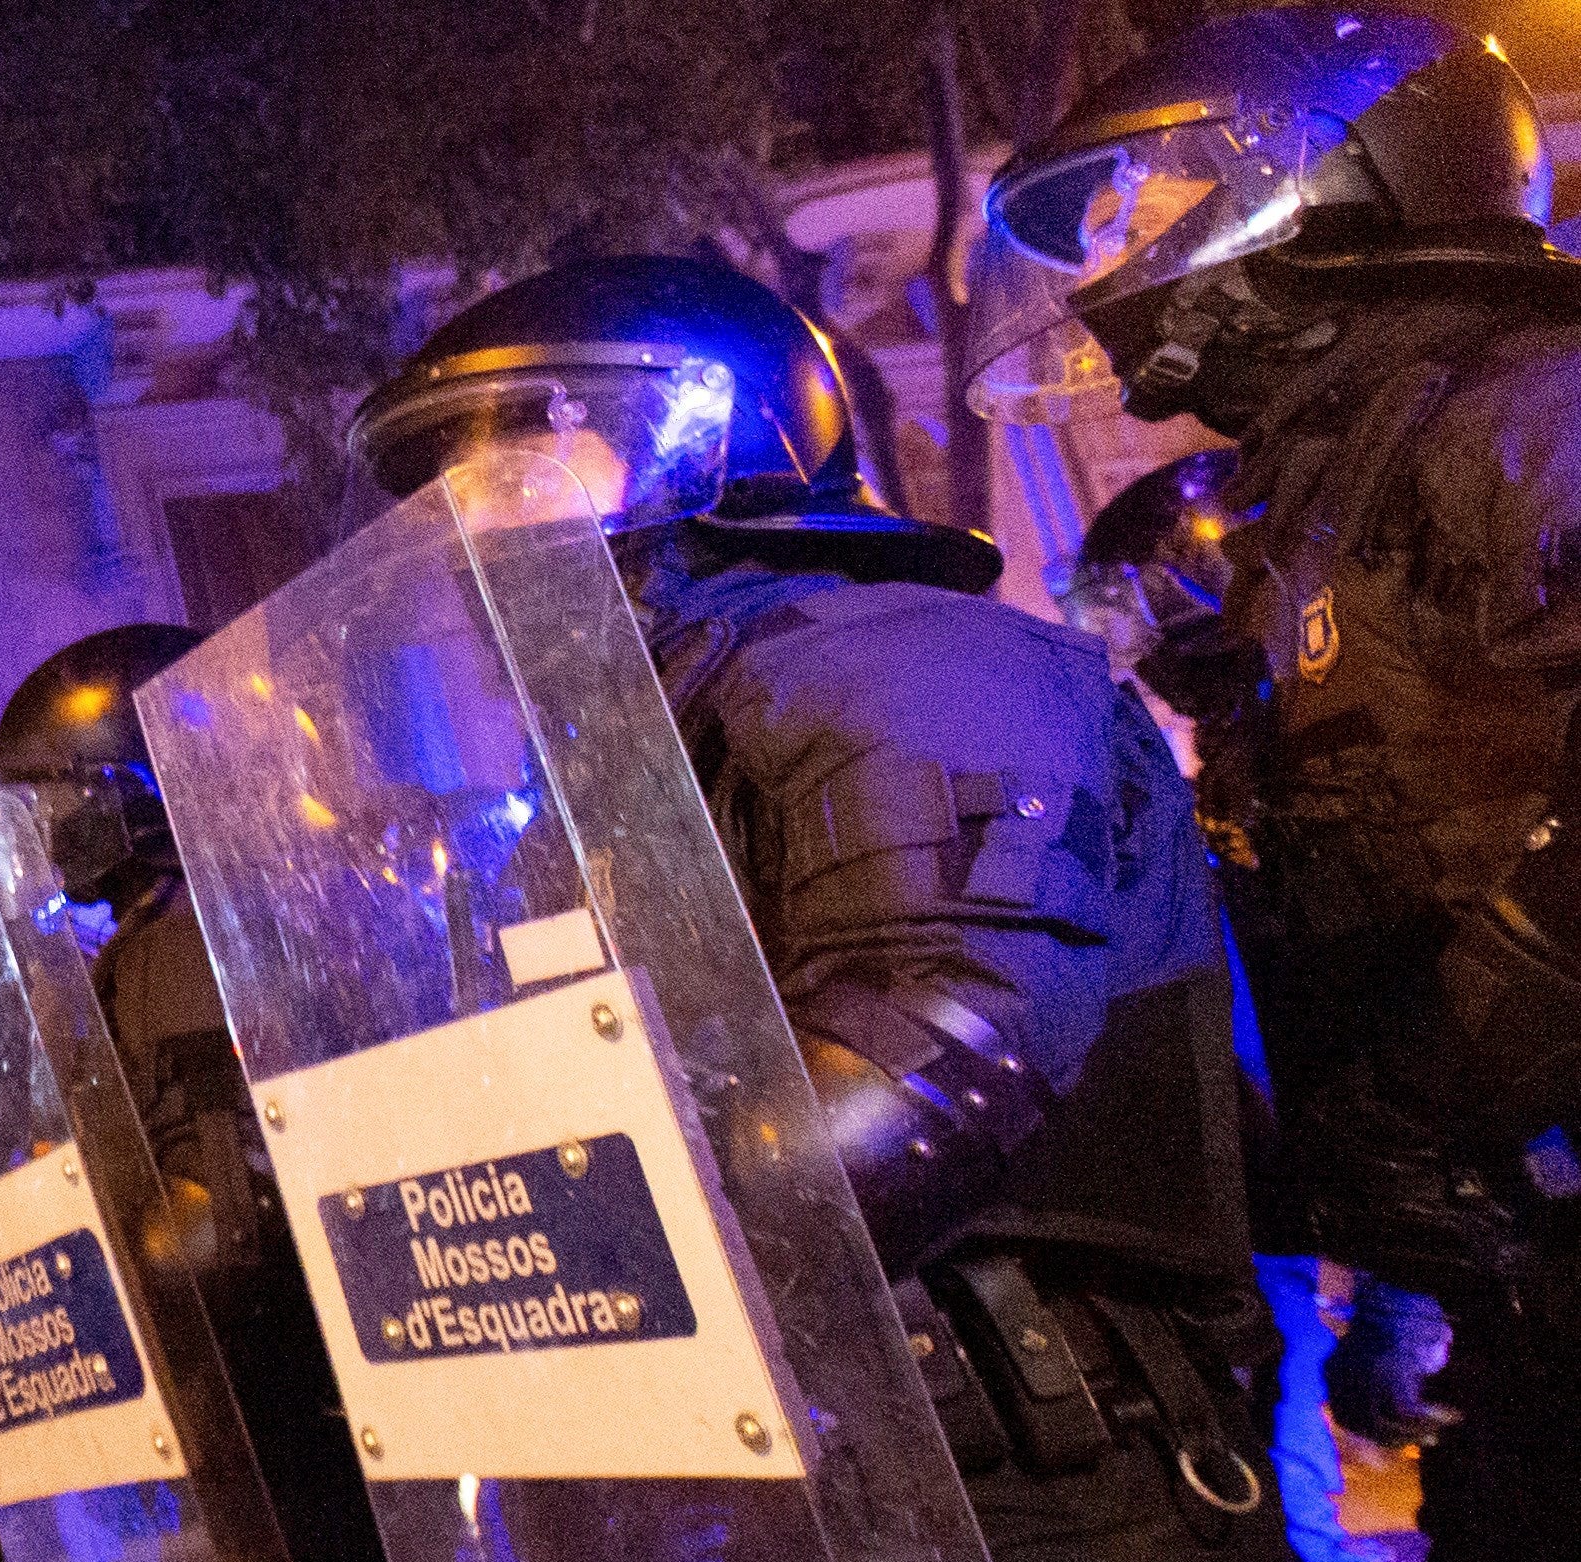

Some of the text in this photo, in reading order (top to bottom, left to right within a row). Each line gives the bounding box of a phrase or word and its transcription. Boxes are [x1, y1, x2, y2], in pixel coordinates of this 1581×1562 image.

[399, 1162, 533, 1233] Policia
[410, 1232, 558, 1290] Mossos
[405, 1281, 619, 1351] d'Esquadra
